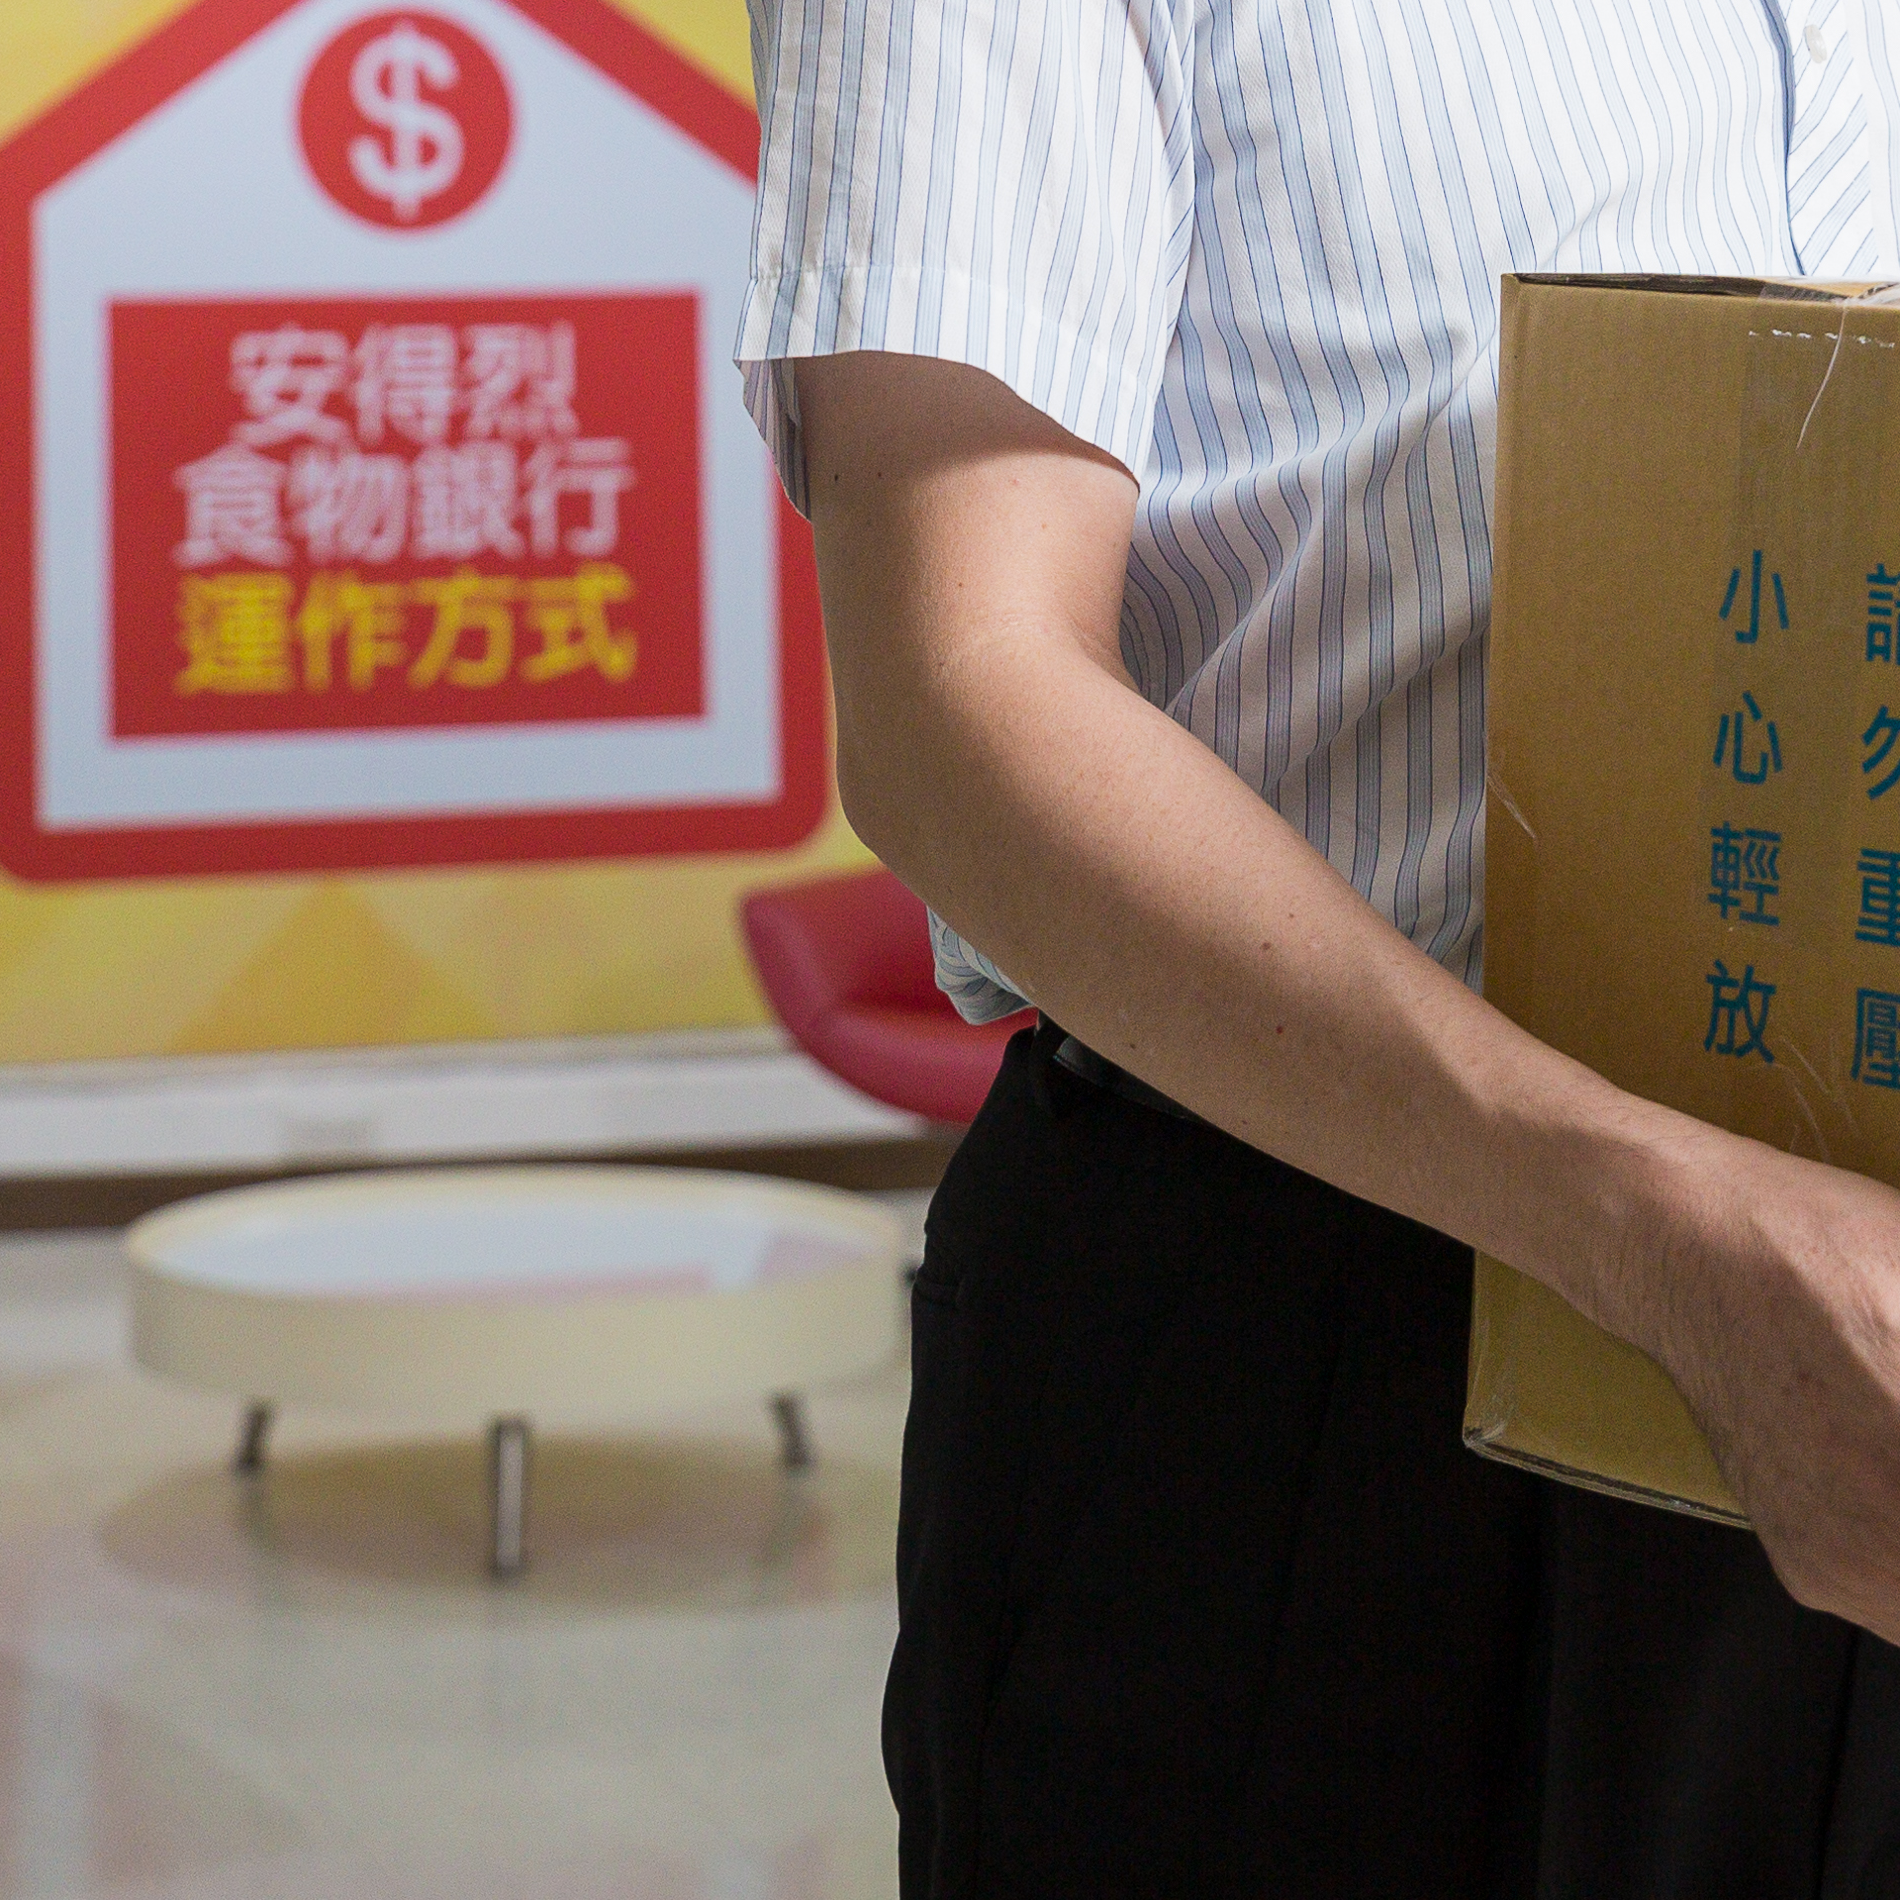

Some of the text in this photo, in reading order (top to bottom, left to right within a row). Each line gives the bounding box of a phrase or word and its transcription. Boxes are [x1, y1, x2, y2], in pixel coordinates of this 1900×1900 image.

[228, 324, 577, 449] 安得烈
[176, 439, 634, 564] 食物銀行
[179, 564, 636, 695] 運作方式
[1704, 549, 1790, 1064] 小心輕放
